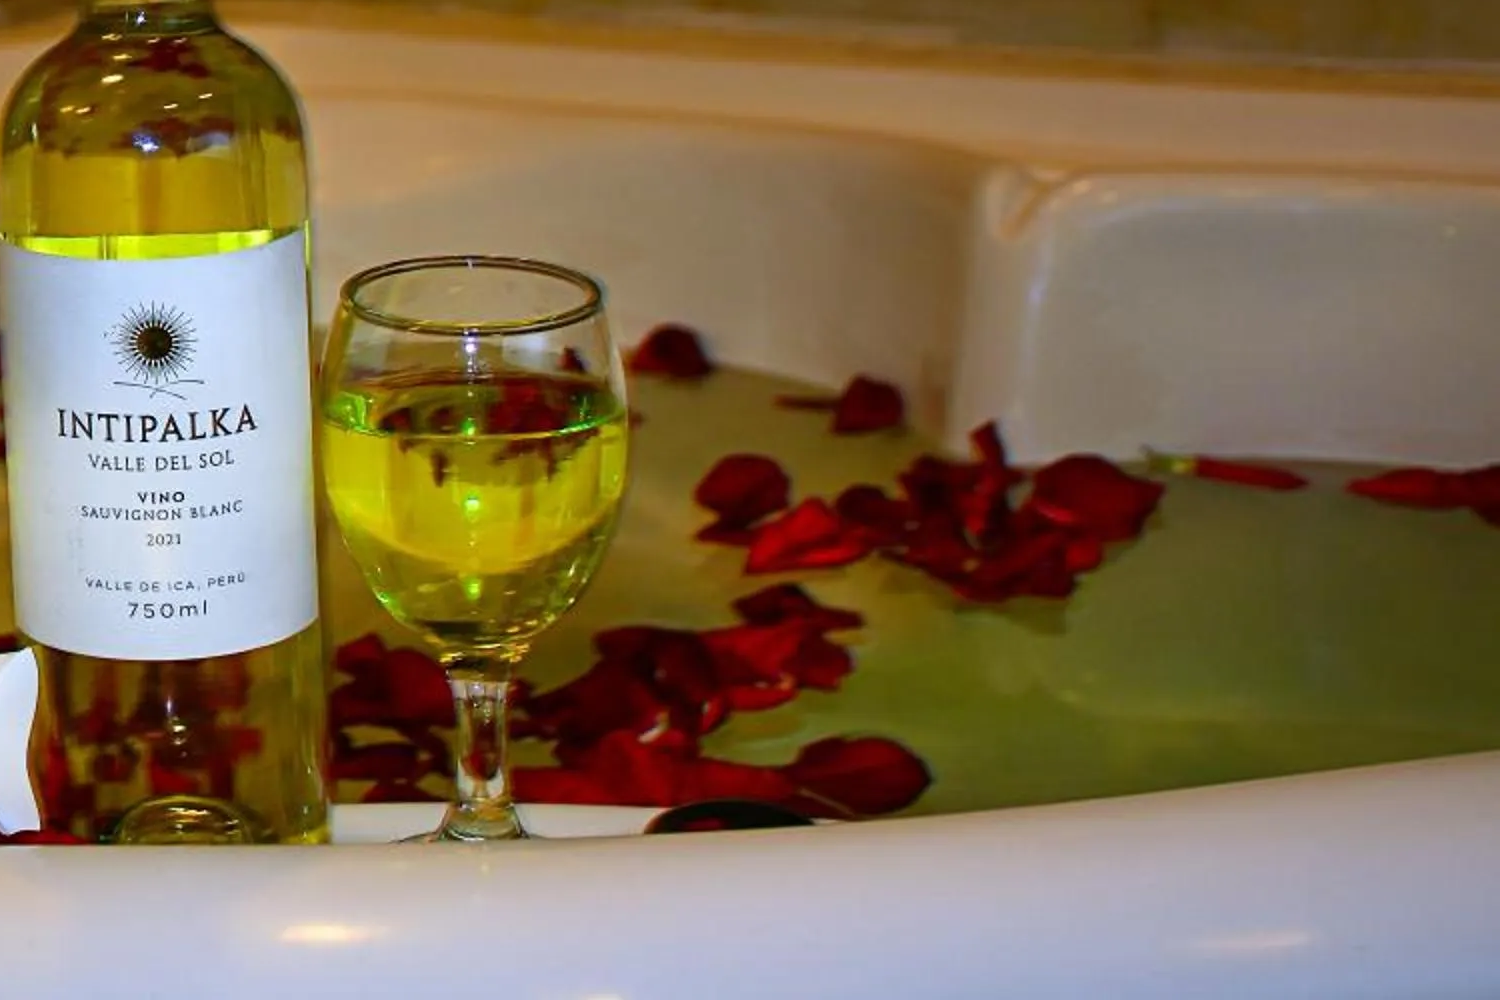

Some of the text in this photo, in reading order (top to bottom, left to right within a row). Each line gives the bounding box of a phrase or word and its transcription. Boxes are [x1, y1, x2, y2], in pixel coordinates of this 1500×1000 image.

[57, 403, 258, 443] INTIPALKA
[88, 449, 235, 472] VALLE DEL SOL
[137, 491, 186, 505] VINO
[81, 500, 243, 521] SAUVIGNON BLANC
[146, 533, 182, 547] 2021
[85, 577, 133, 592] VALLE
[139, 581, 161, 593] DE
[128, 599, 207, 619] 750ml
